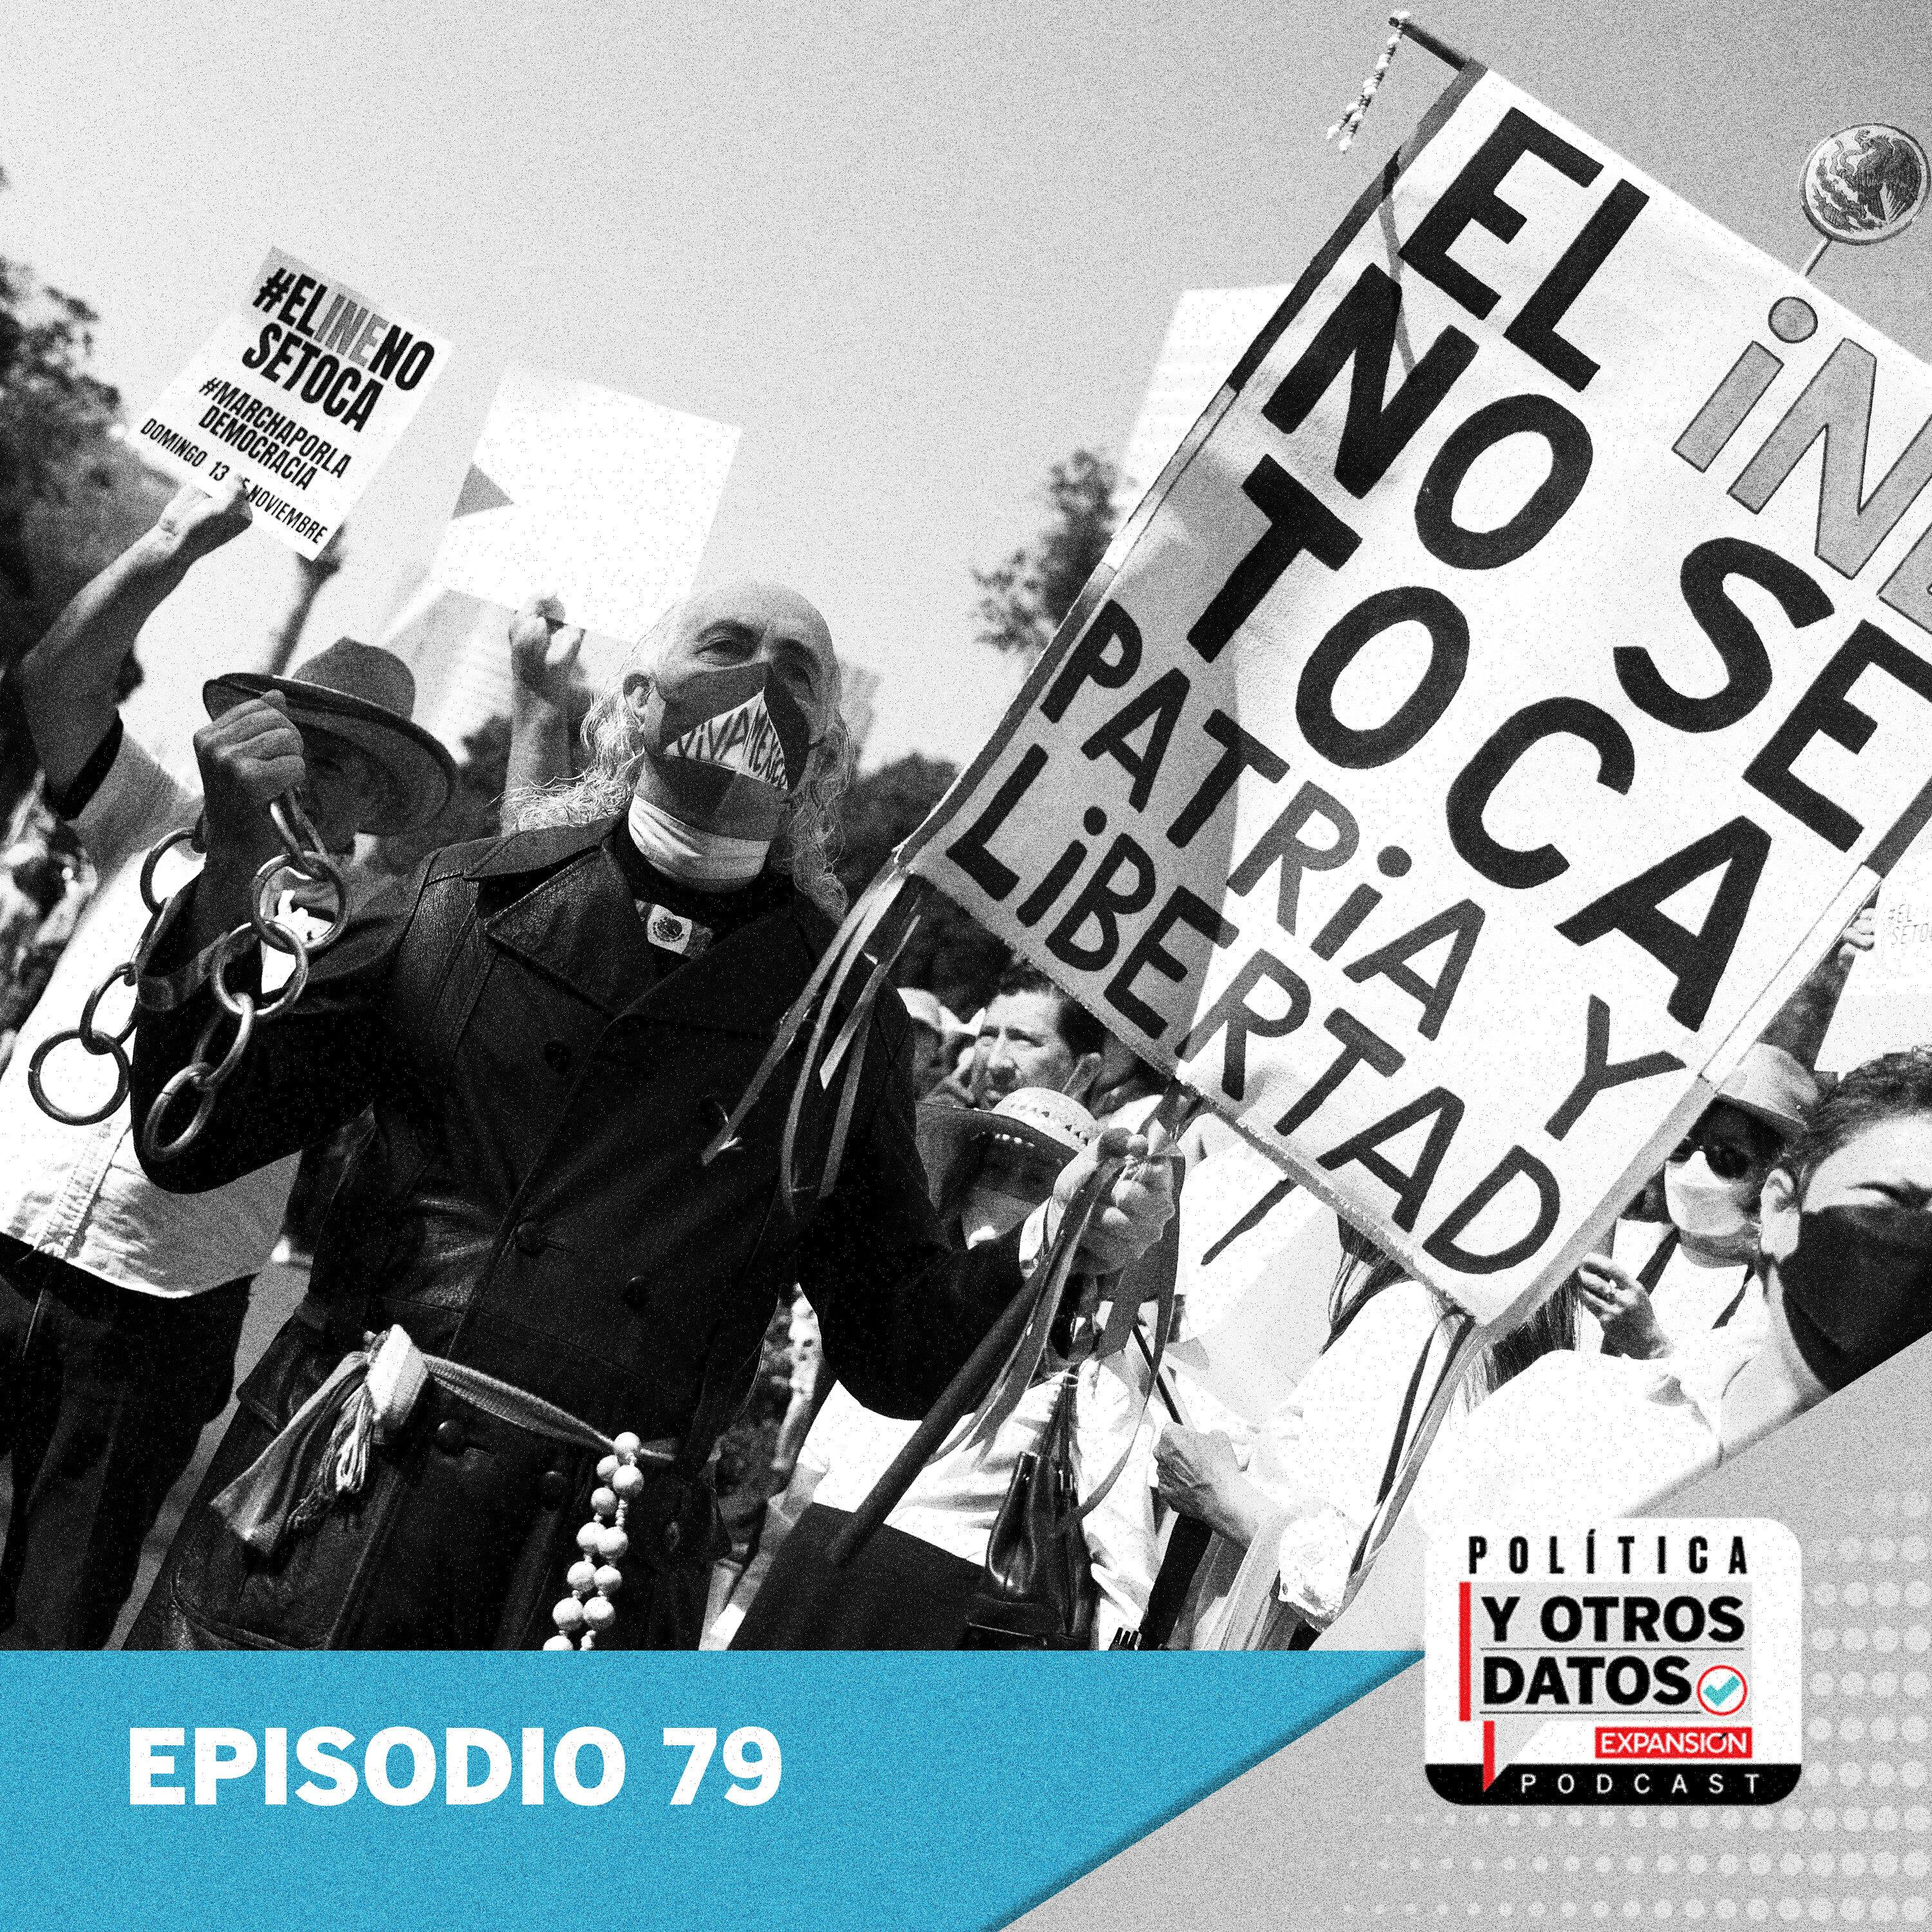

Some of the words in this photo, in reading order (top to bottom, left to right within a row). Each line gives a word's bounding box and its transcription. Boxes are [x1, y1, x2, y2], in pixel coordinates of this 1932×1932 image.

[242, 323, 384, 432] SETOCA
[252, 268, 435, 391] #ELINENO
[1399, 106, 1650, 392] EL
[1671, 296, 1932, 634] iN
[140, 418, 206, 468] DOMINGO
[209, 460, 230, 482] 13
[246, 485, 328, 544] NOVIEMBRE
[198, 377, 352, 478] #MARCHAPORLA
[198, 406, 317, 490] DEMOCRACIA
[1261, 263, 1593, 570] NO
[1613, 536, 1932, 853] SE
[1186, 453, 1772, 1031] TOCA
[1891, 923, 1932, 945] SETO
[1544, 994, 1686, 1141] Y
